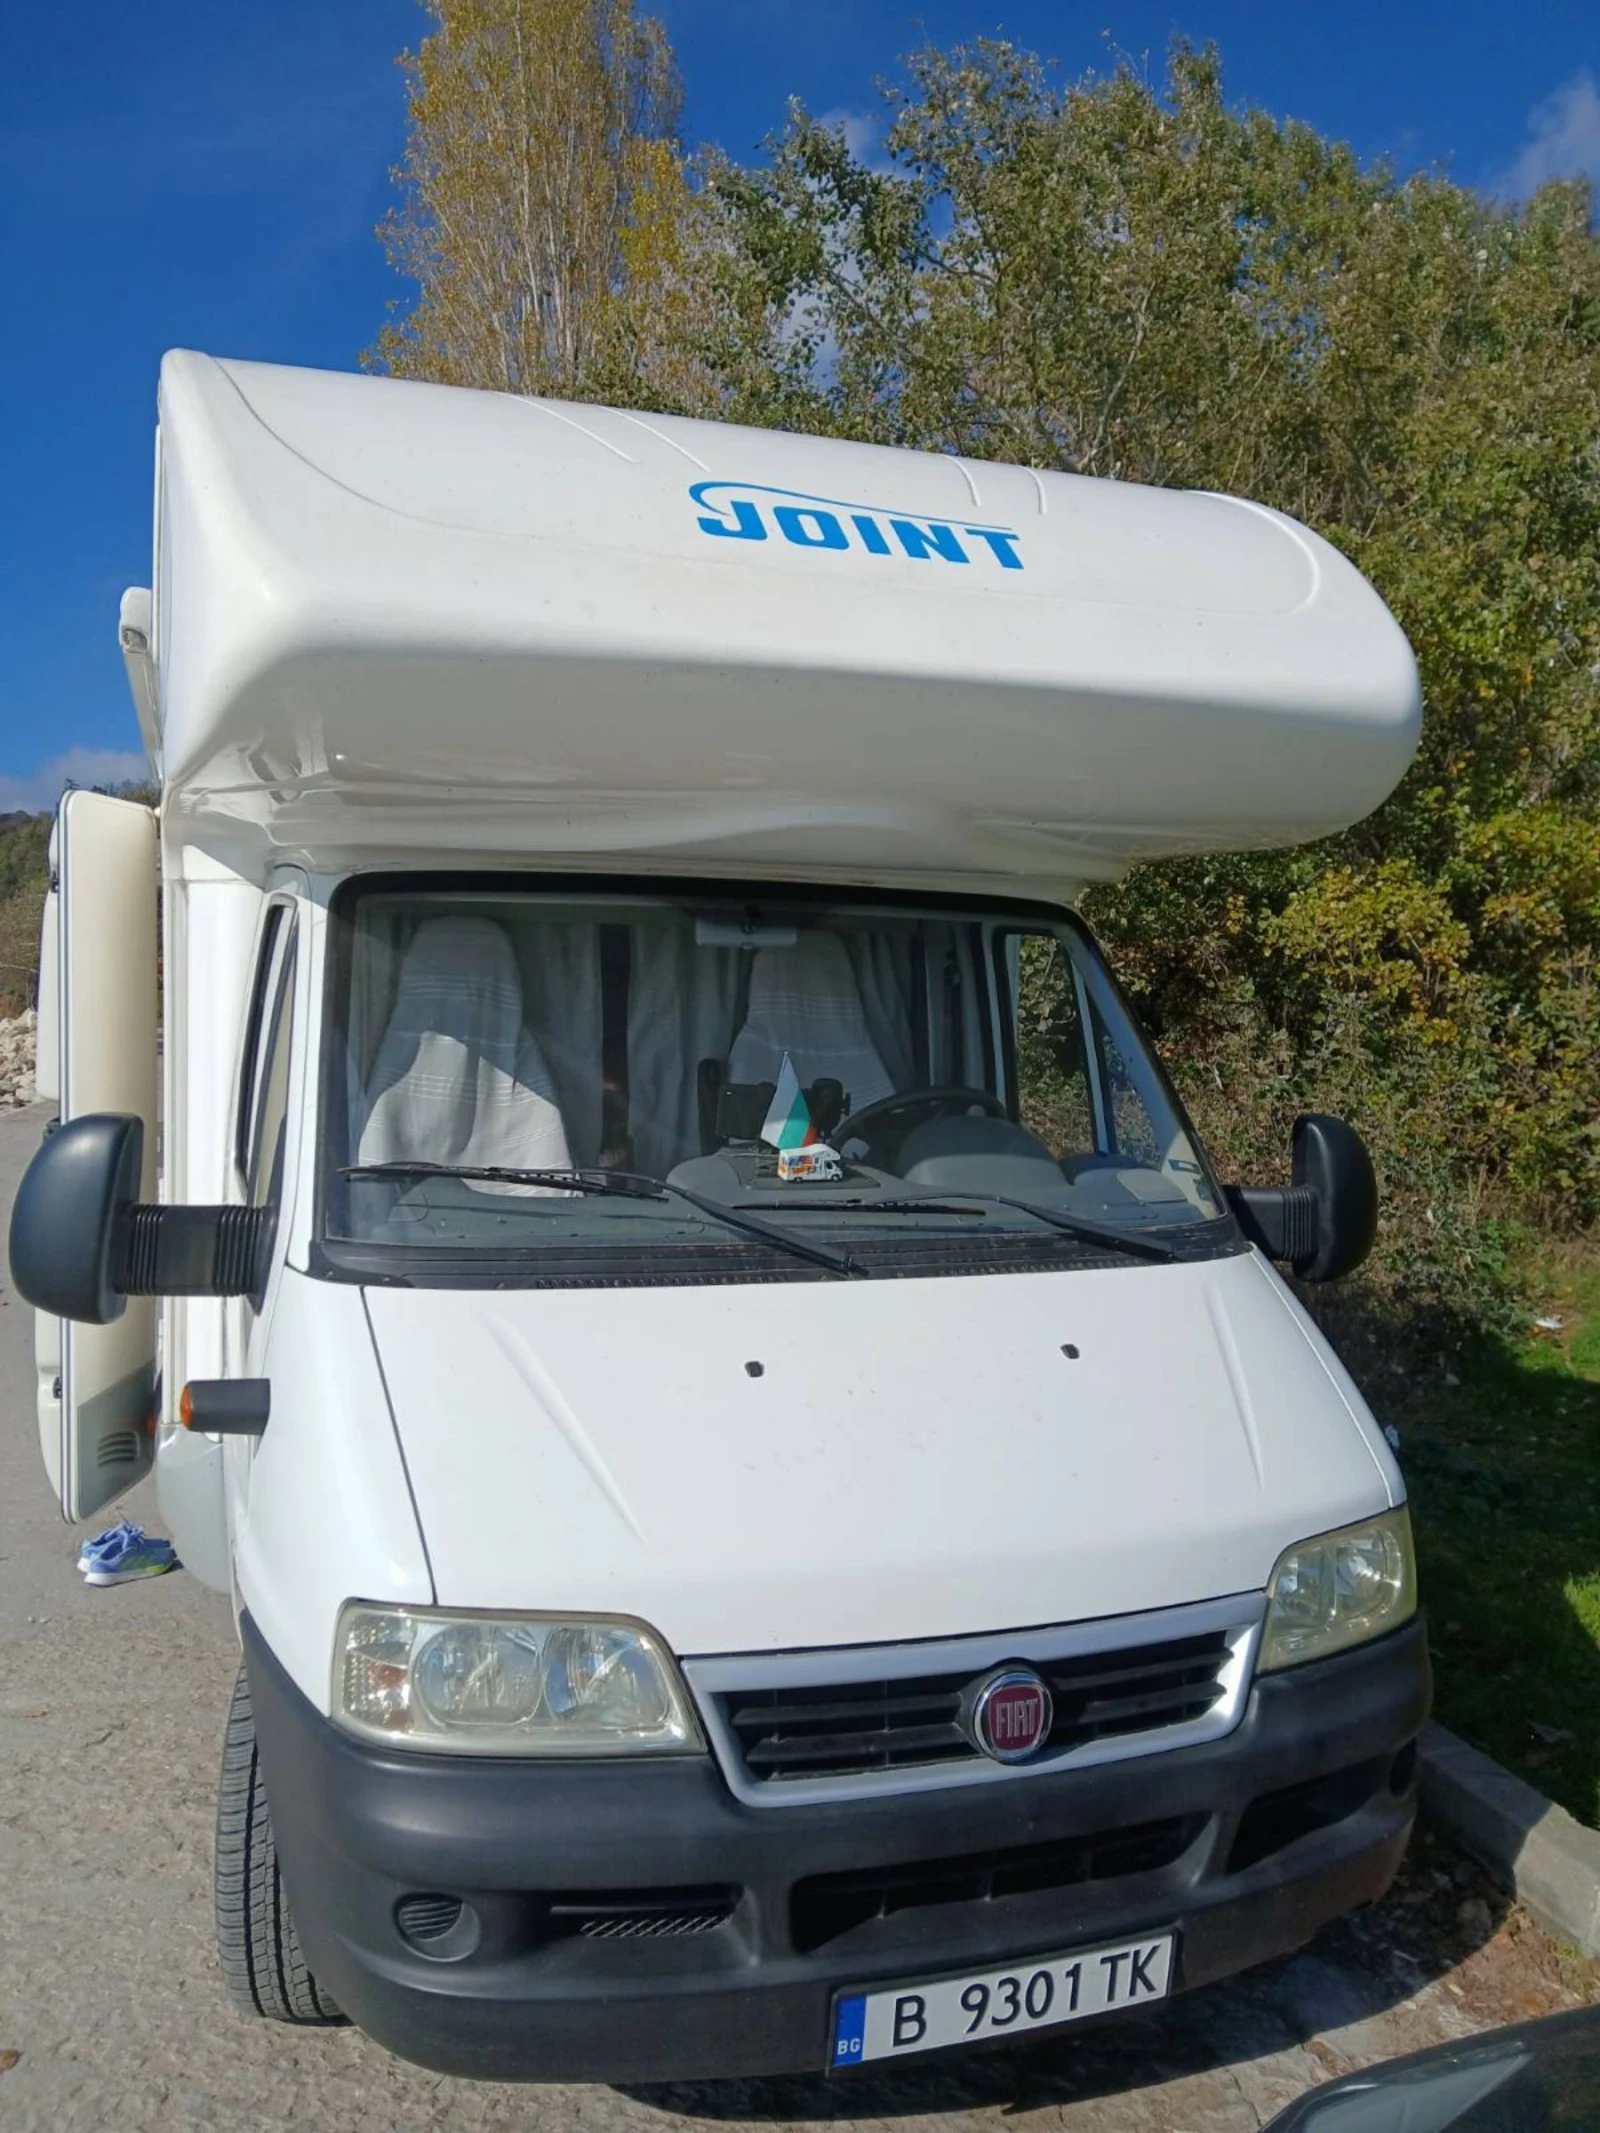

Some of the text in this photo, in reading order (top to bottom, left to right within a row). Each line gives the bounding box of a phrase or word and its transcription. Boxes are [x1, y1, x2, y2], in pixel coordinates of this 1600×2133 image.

[695, 498, 1025, 570] JOINT
[995, 1697, 1039, 1740] FIAT
[892, 1995, 927, 2048] B
[837, 2037, 861, 2056] BG
